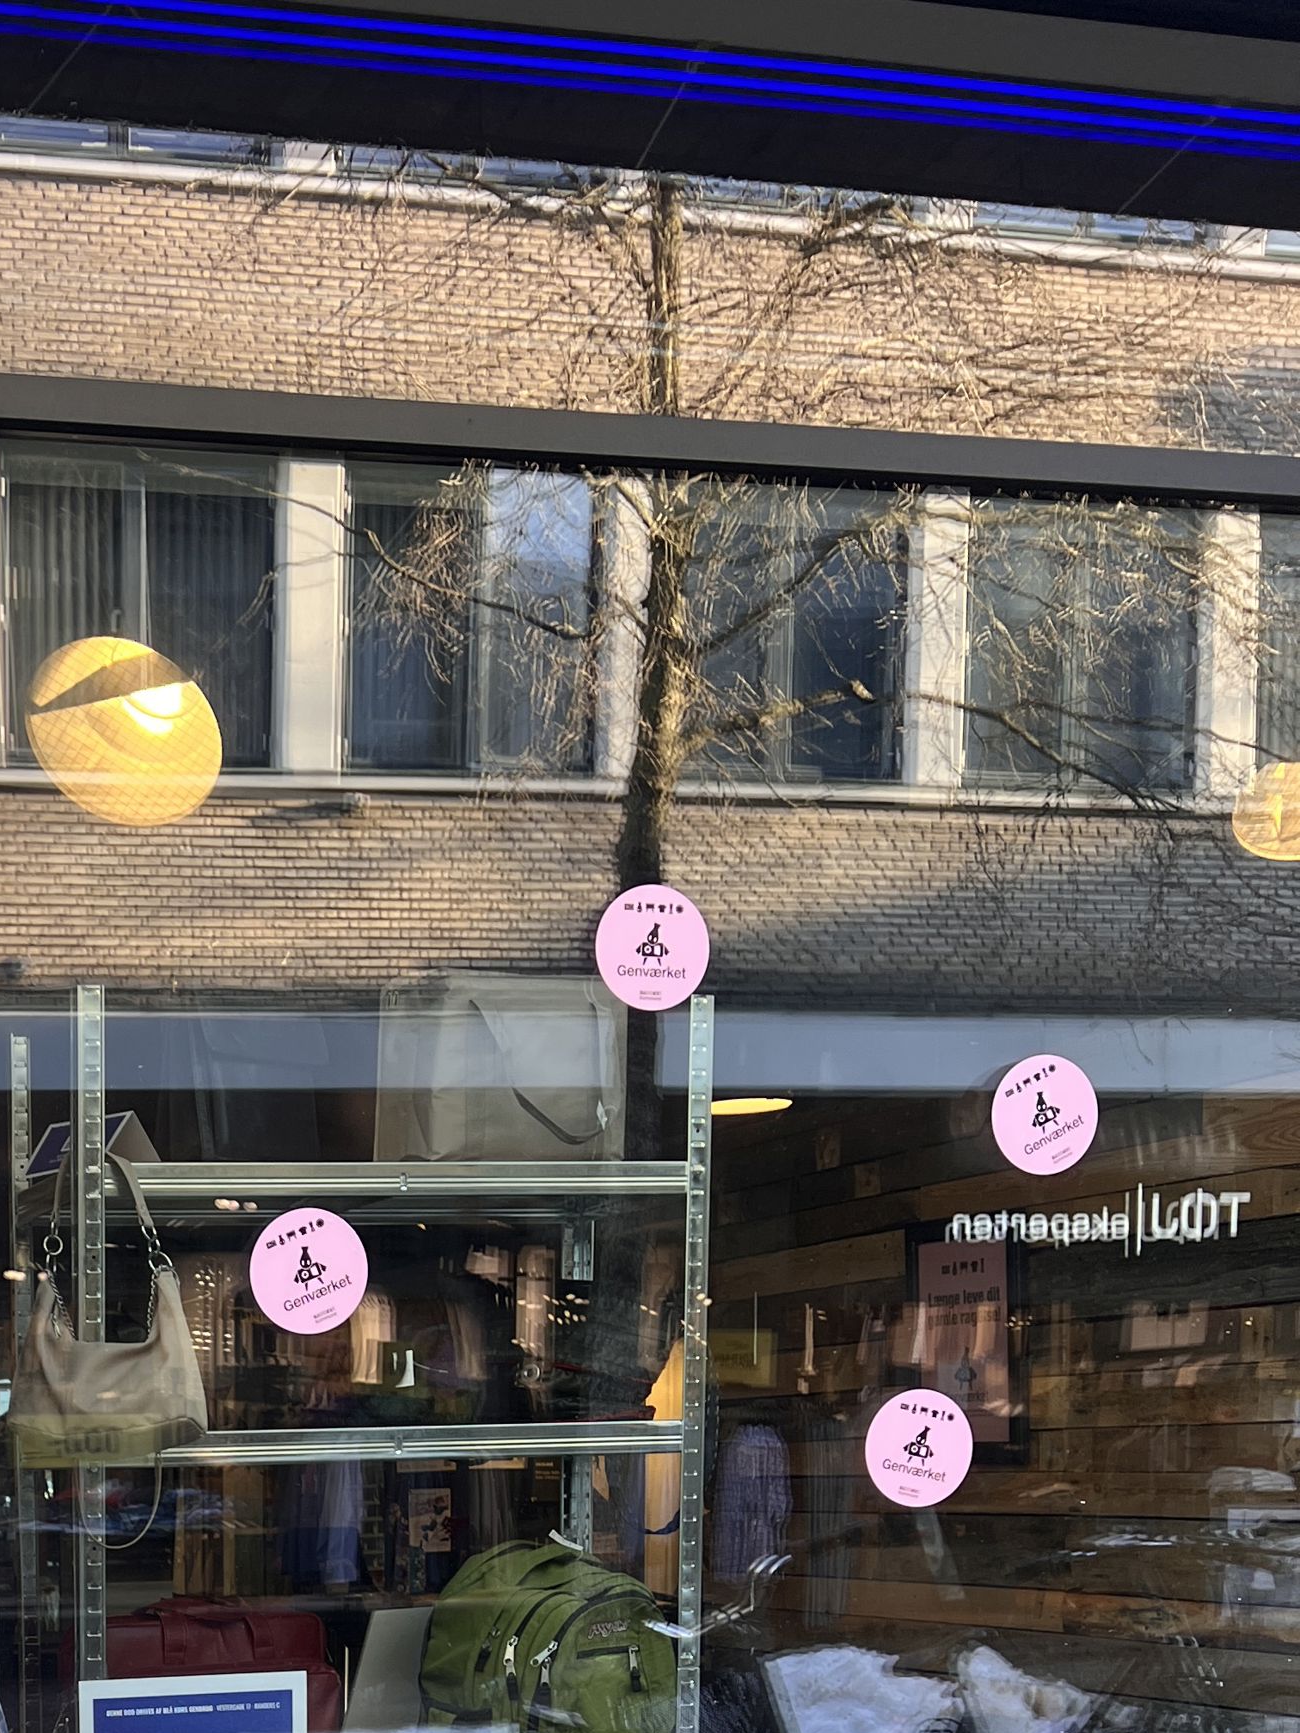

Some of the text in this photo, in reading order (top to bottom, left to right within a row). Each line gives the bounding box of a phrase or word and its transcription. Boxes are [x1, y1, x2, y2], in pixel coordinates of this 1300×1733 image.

[616, 963, 687, 980] Genværket
[1023, 1114, 1085, 1156] Genværket
[283, 1273, 353, 1312] Genværket
[882, 1458, 947, 1482] Genværket
